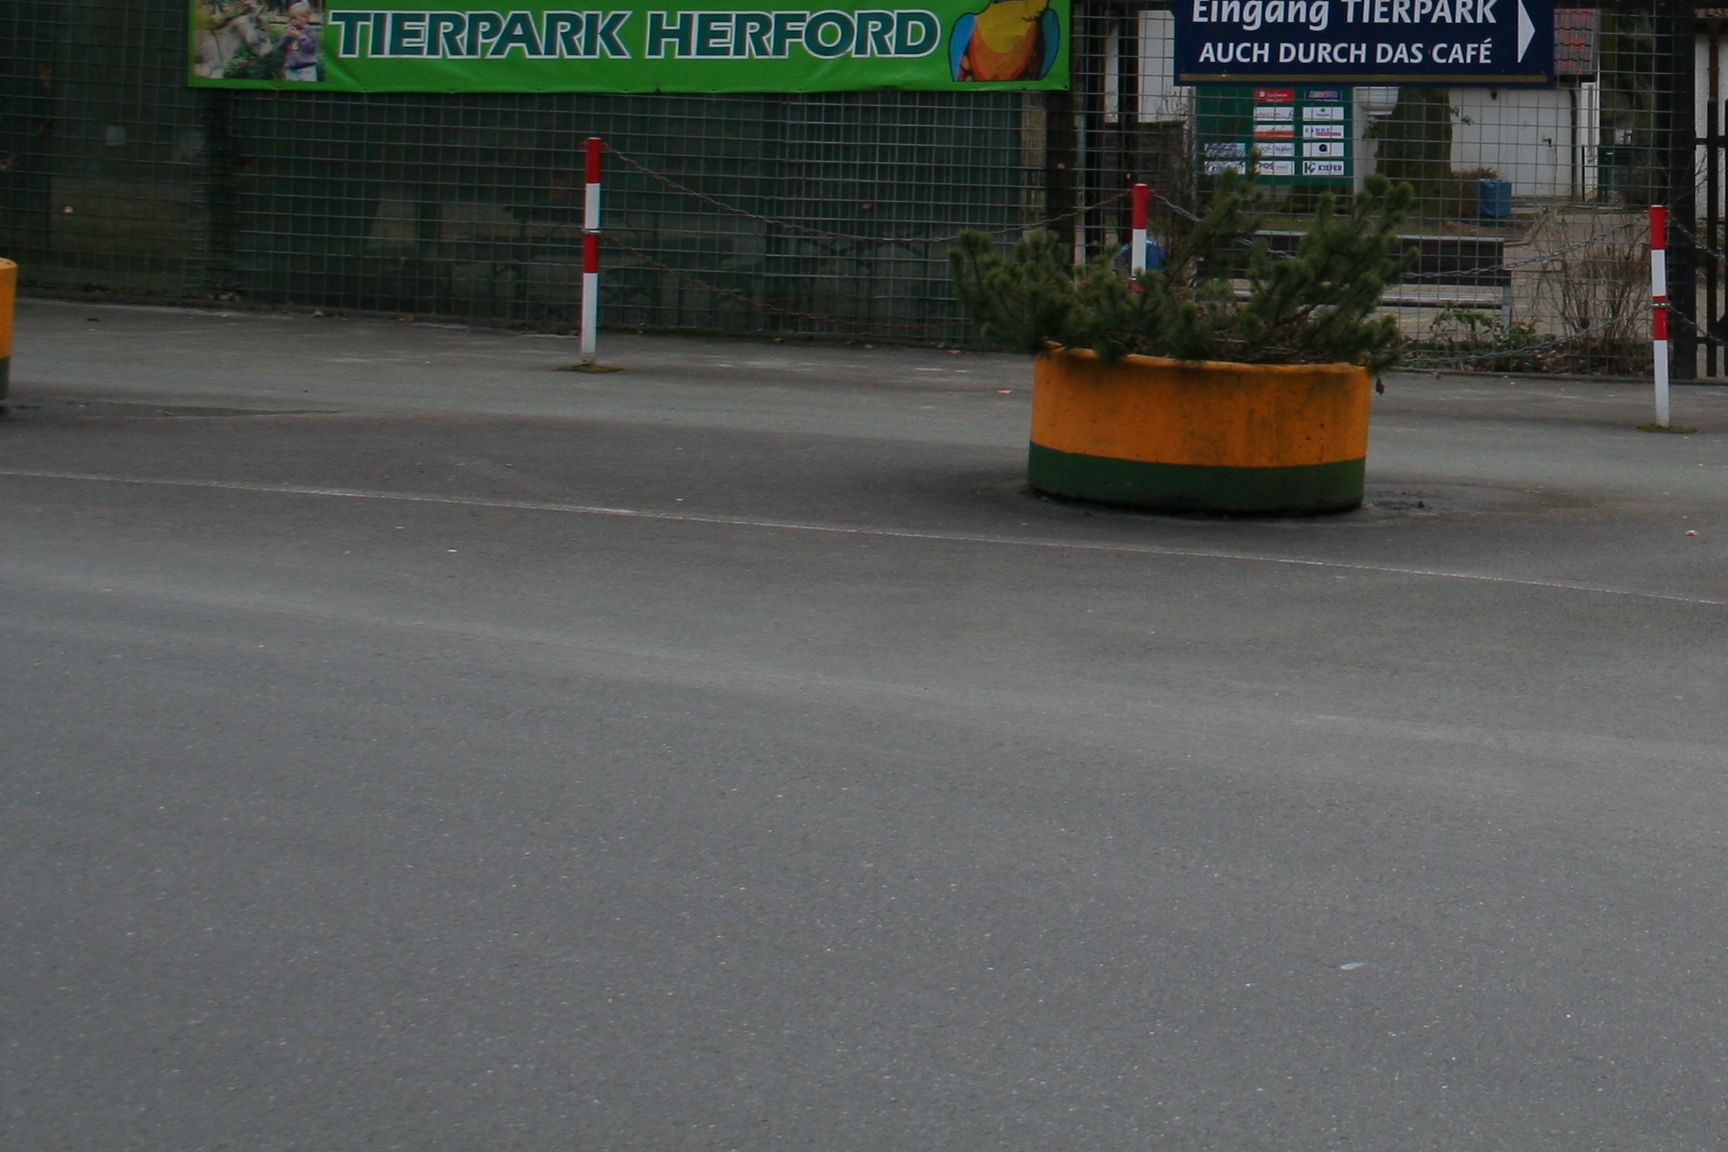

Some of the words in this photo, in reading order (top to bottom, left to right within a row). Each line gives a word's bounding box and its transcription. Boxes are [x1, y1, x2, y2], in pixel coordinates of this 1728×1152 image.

[330, 9, 632, 59] TIERPARK
[645, 9, 940, 59] HERFORD
[1198, 42, 1270, 64] AUCH
[1278, 42, 1367, 64] DURCH
[1375, 42, 1423, 64] DAS
[1431, 38, 1493, 64] CAFÉ
